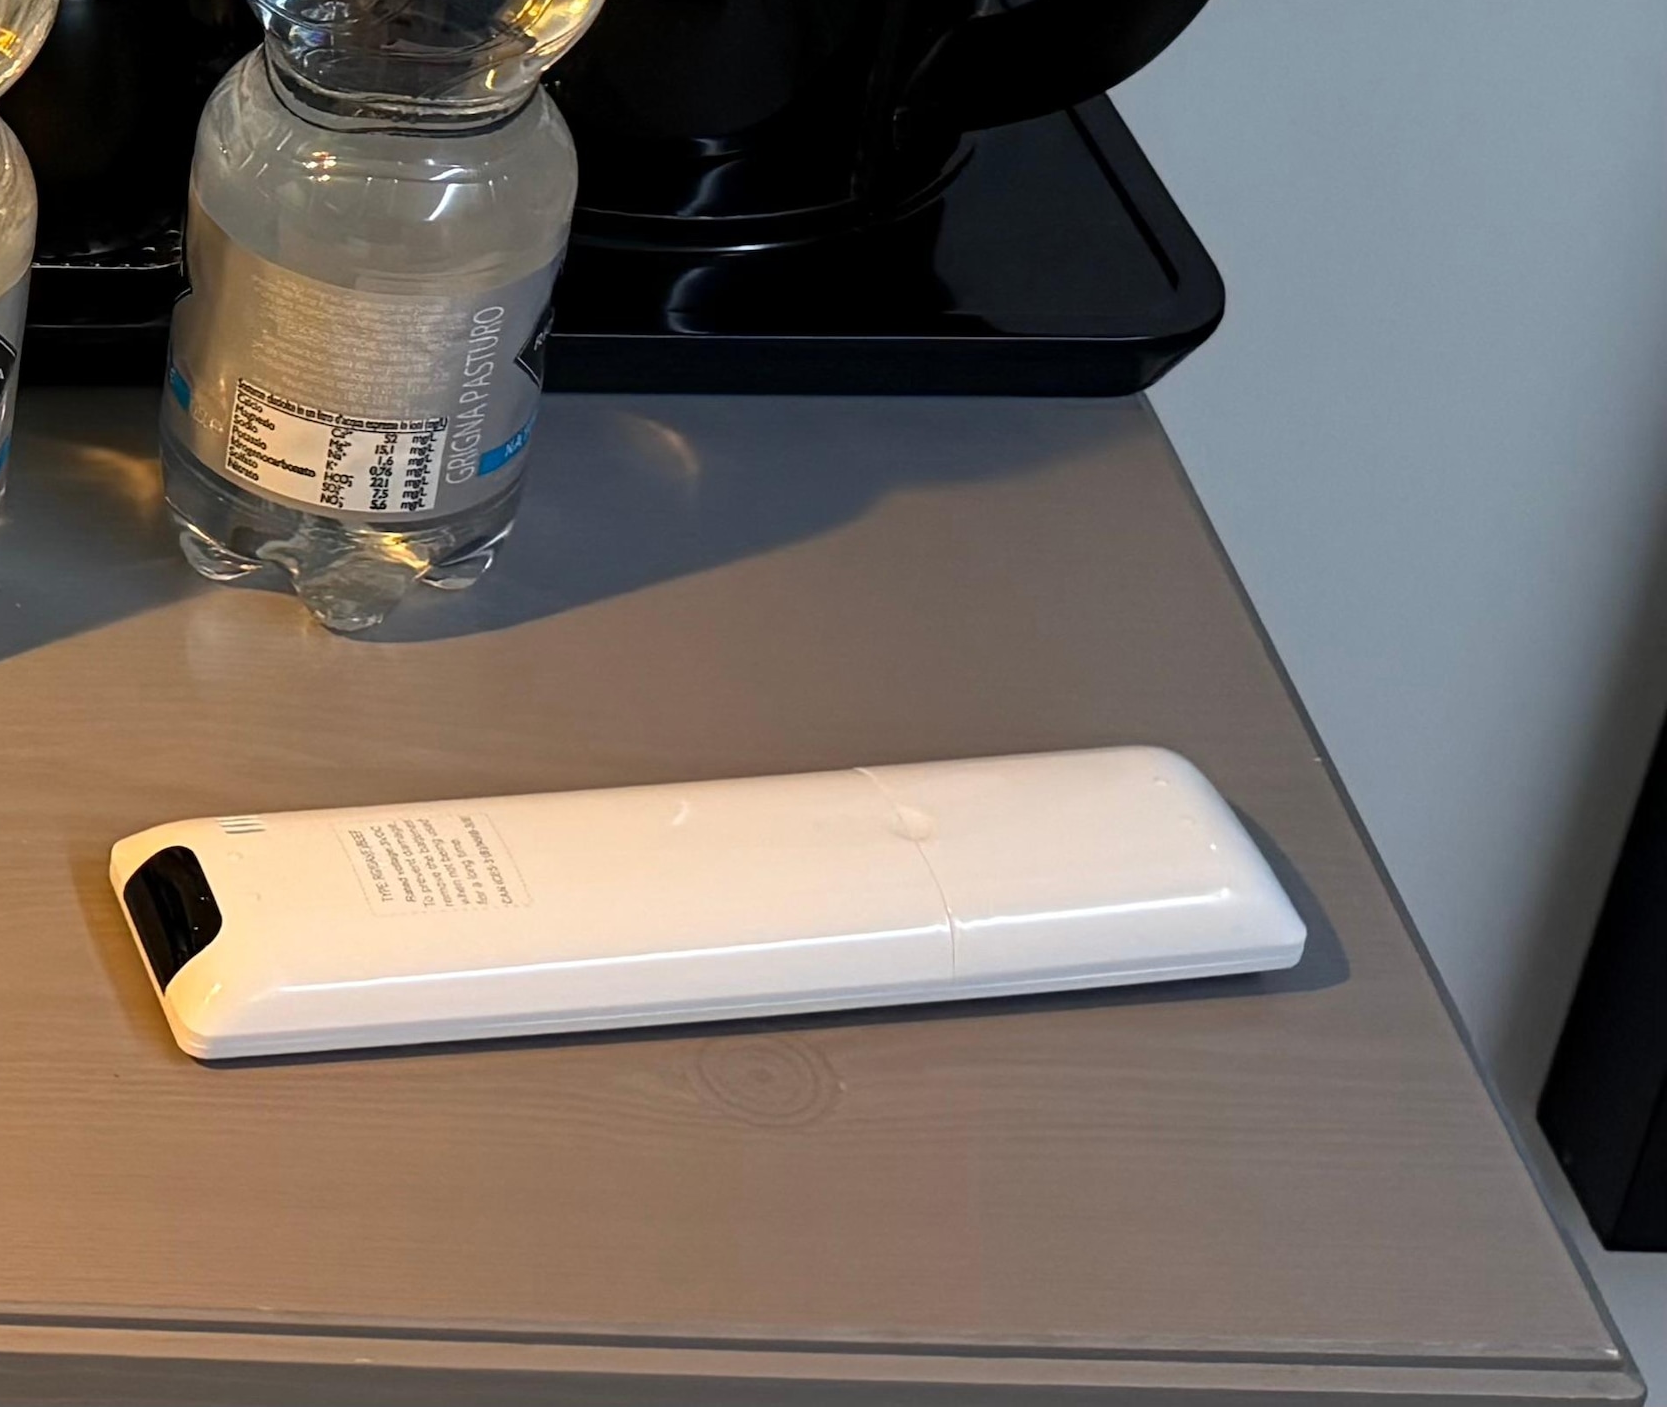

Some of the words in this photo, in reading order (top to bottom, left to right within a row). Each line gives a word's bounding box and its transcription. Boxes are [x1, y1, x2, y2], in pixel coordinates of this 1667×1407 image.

[459, 306, 505, 404] PASTURO
[234, 414, 258, 433] Sodio
[237, 393, 263, 413] Calcio
[385, 434, 397, 444] 52
[446, 402, 489, 485] GRIGNA
[369, 477, 389, 488] 221
[433, 839, 451, 861] being
[407, 859, 431, 892] prevent
[445, 864, 458, 876] not
[460, 860, 480, 878] long
[397, 878, 416, 901] Rated
[422, 896, 436, 906] To
